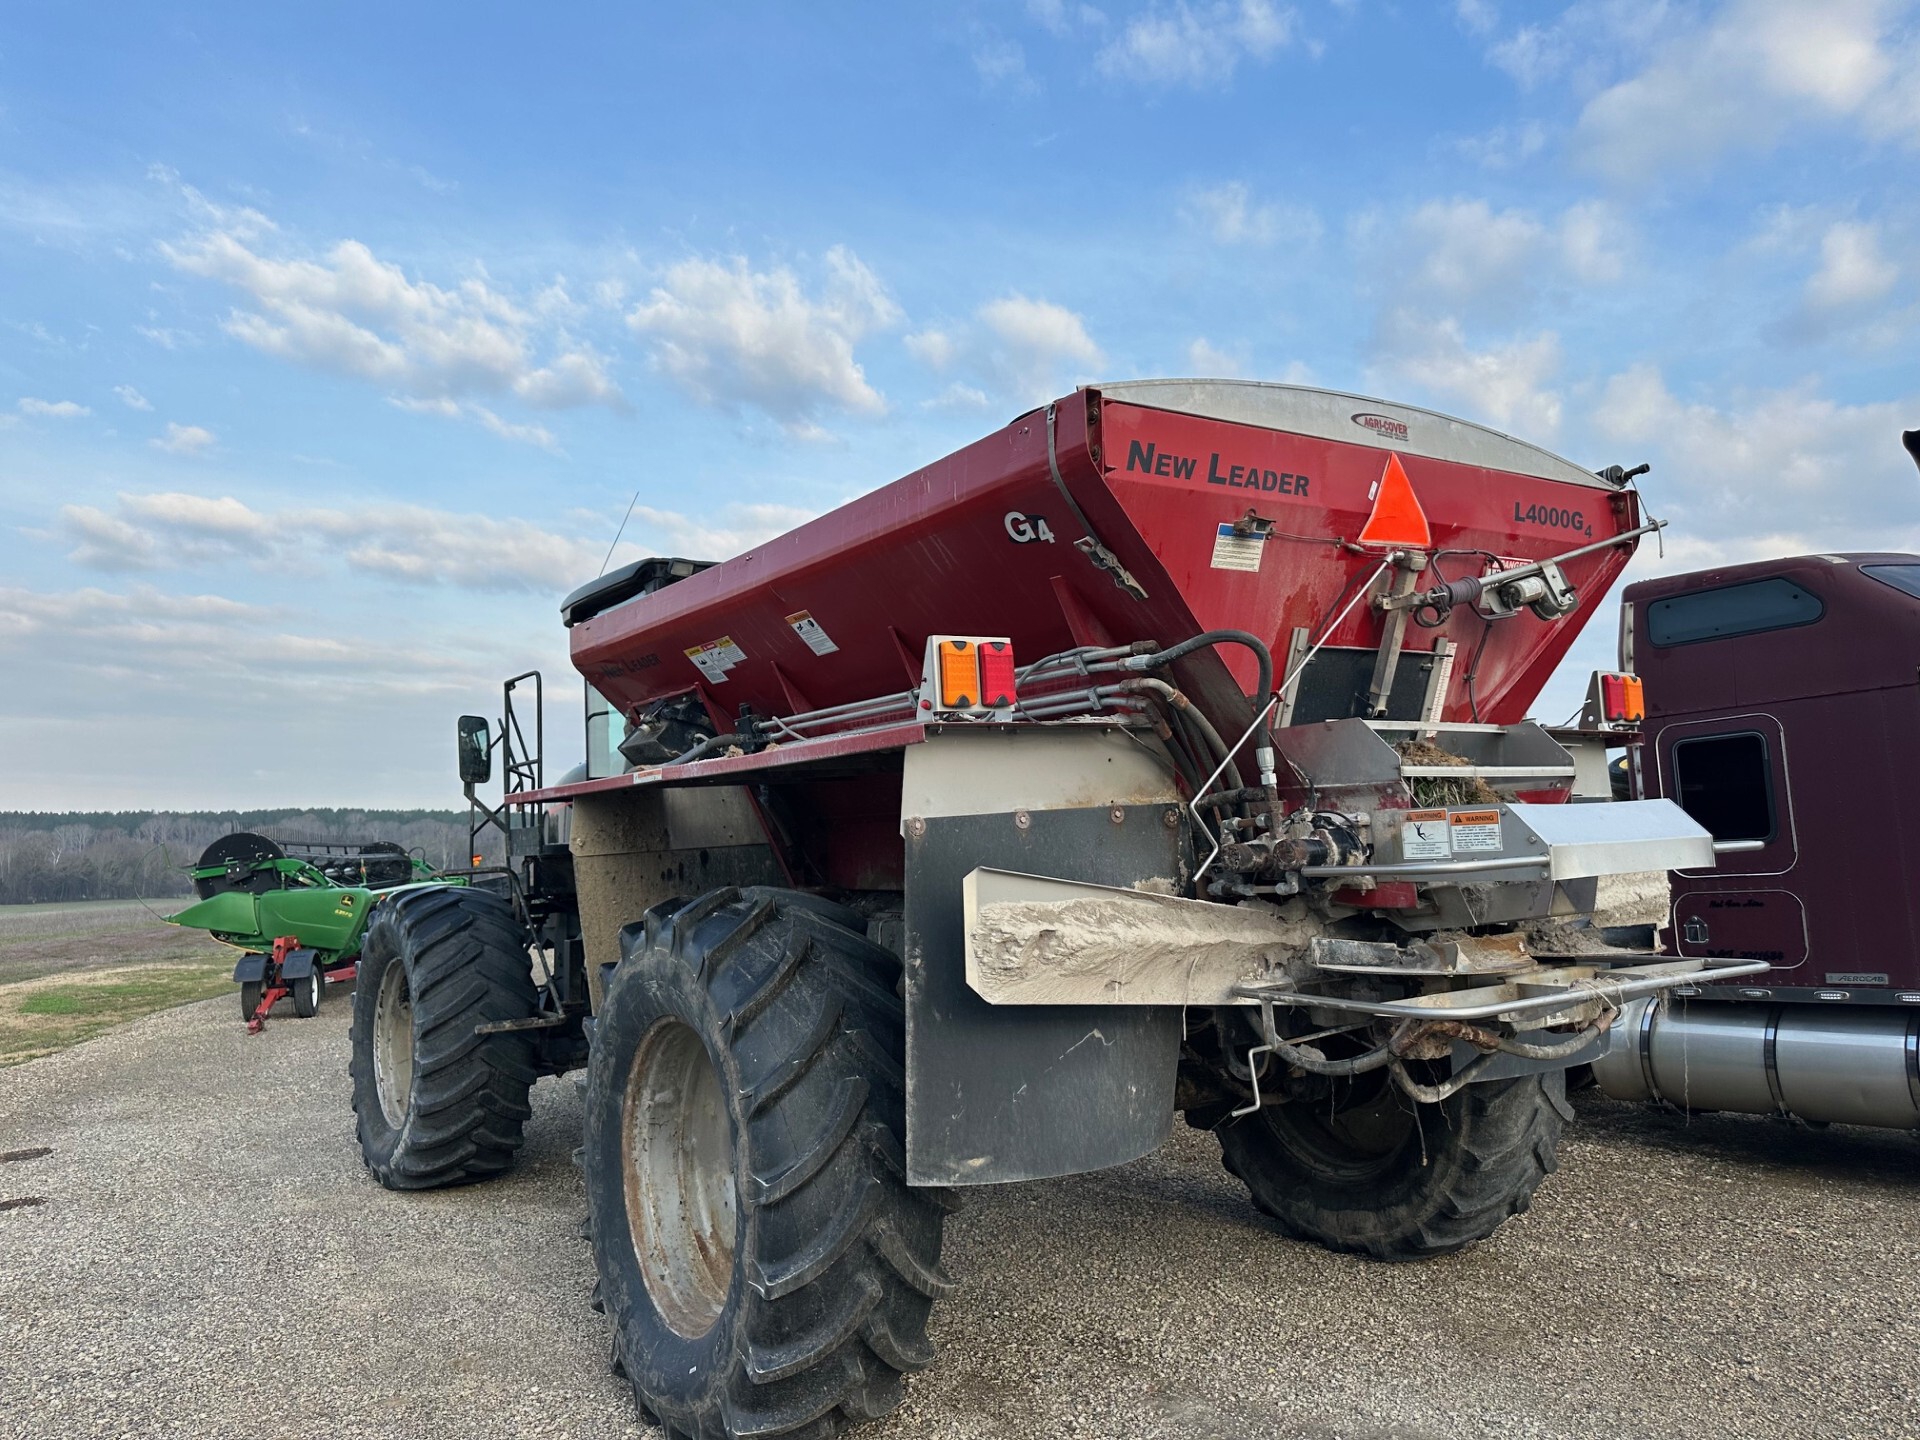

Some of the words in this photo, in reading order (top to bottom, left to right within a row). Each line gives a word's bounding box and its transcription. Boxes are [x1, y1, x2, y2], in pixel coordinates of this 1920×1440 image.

[1364, 416, 1408, 435] AGRI-COVER
[1127, 440, 1197, 480] NEW
[1207, 453, 1310, 497] LEADER
[1004, 511, 1055, 544] G4
[623, 653, 662, 672] LEADER
[1414, 812, 1442, 820] WARNING
[1464, 814, 1494, 822] WARNING
[1838, 975, 1885, 983] AEROCAB
